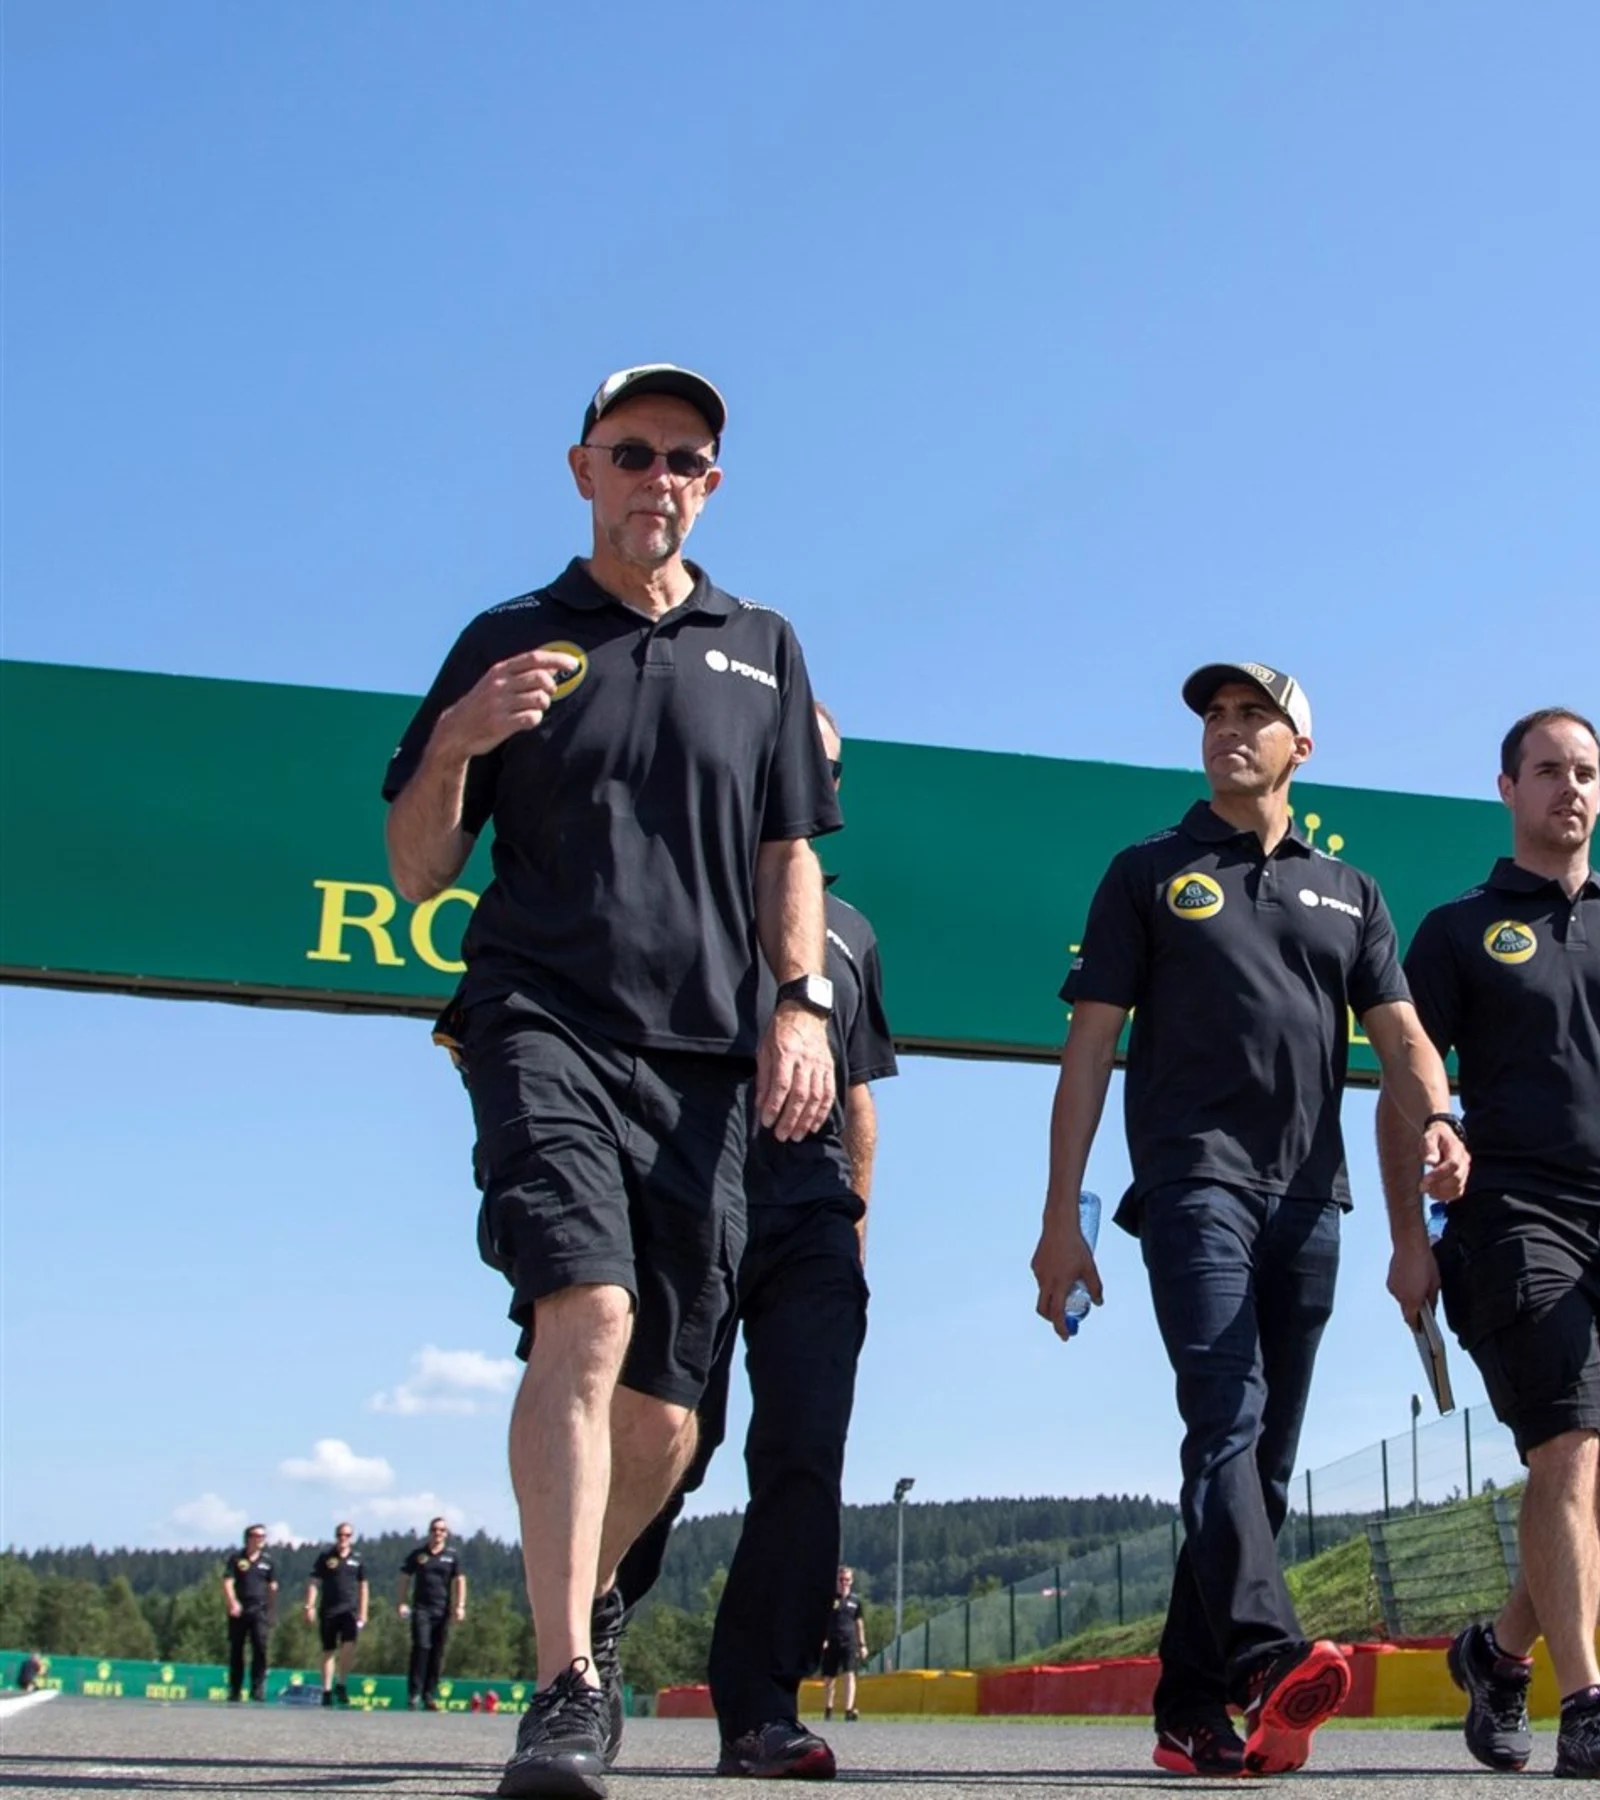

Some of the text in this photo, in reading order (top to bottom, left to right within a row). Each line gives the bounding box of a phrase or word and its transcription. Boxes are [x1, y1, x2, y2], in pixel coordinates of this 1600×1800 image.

[730, 659, 777, 689] PDVSA
[1177, 894, 1217, 907] LOTUS
[1495, 939, 1530, 951] LOTUS
